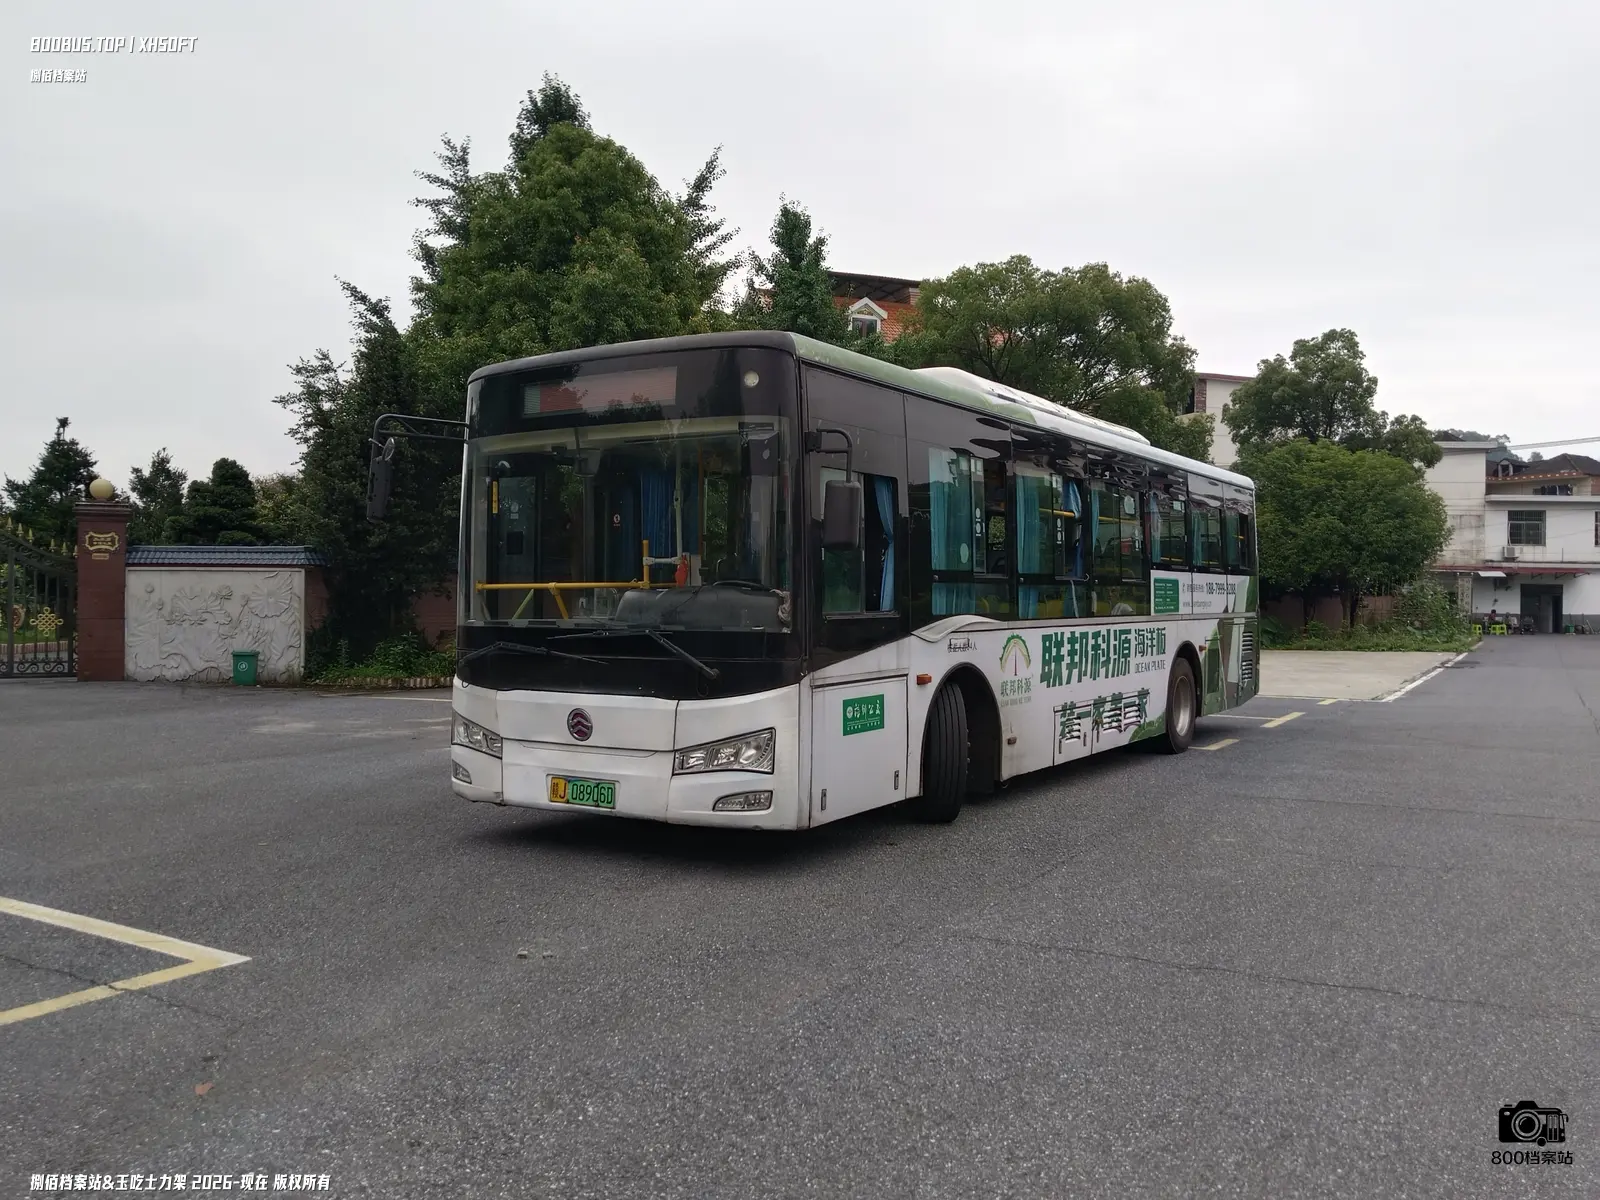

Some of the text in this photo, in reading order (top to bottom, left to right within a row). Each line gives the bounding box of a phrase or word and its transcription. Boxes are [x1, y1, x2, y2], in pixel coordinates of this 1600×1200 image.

[1040, 627, 1167, 689] 联邦科源 海洋板
[1150, 659, 1167, 671] PLATE
